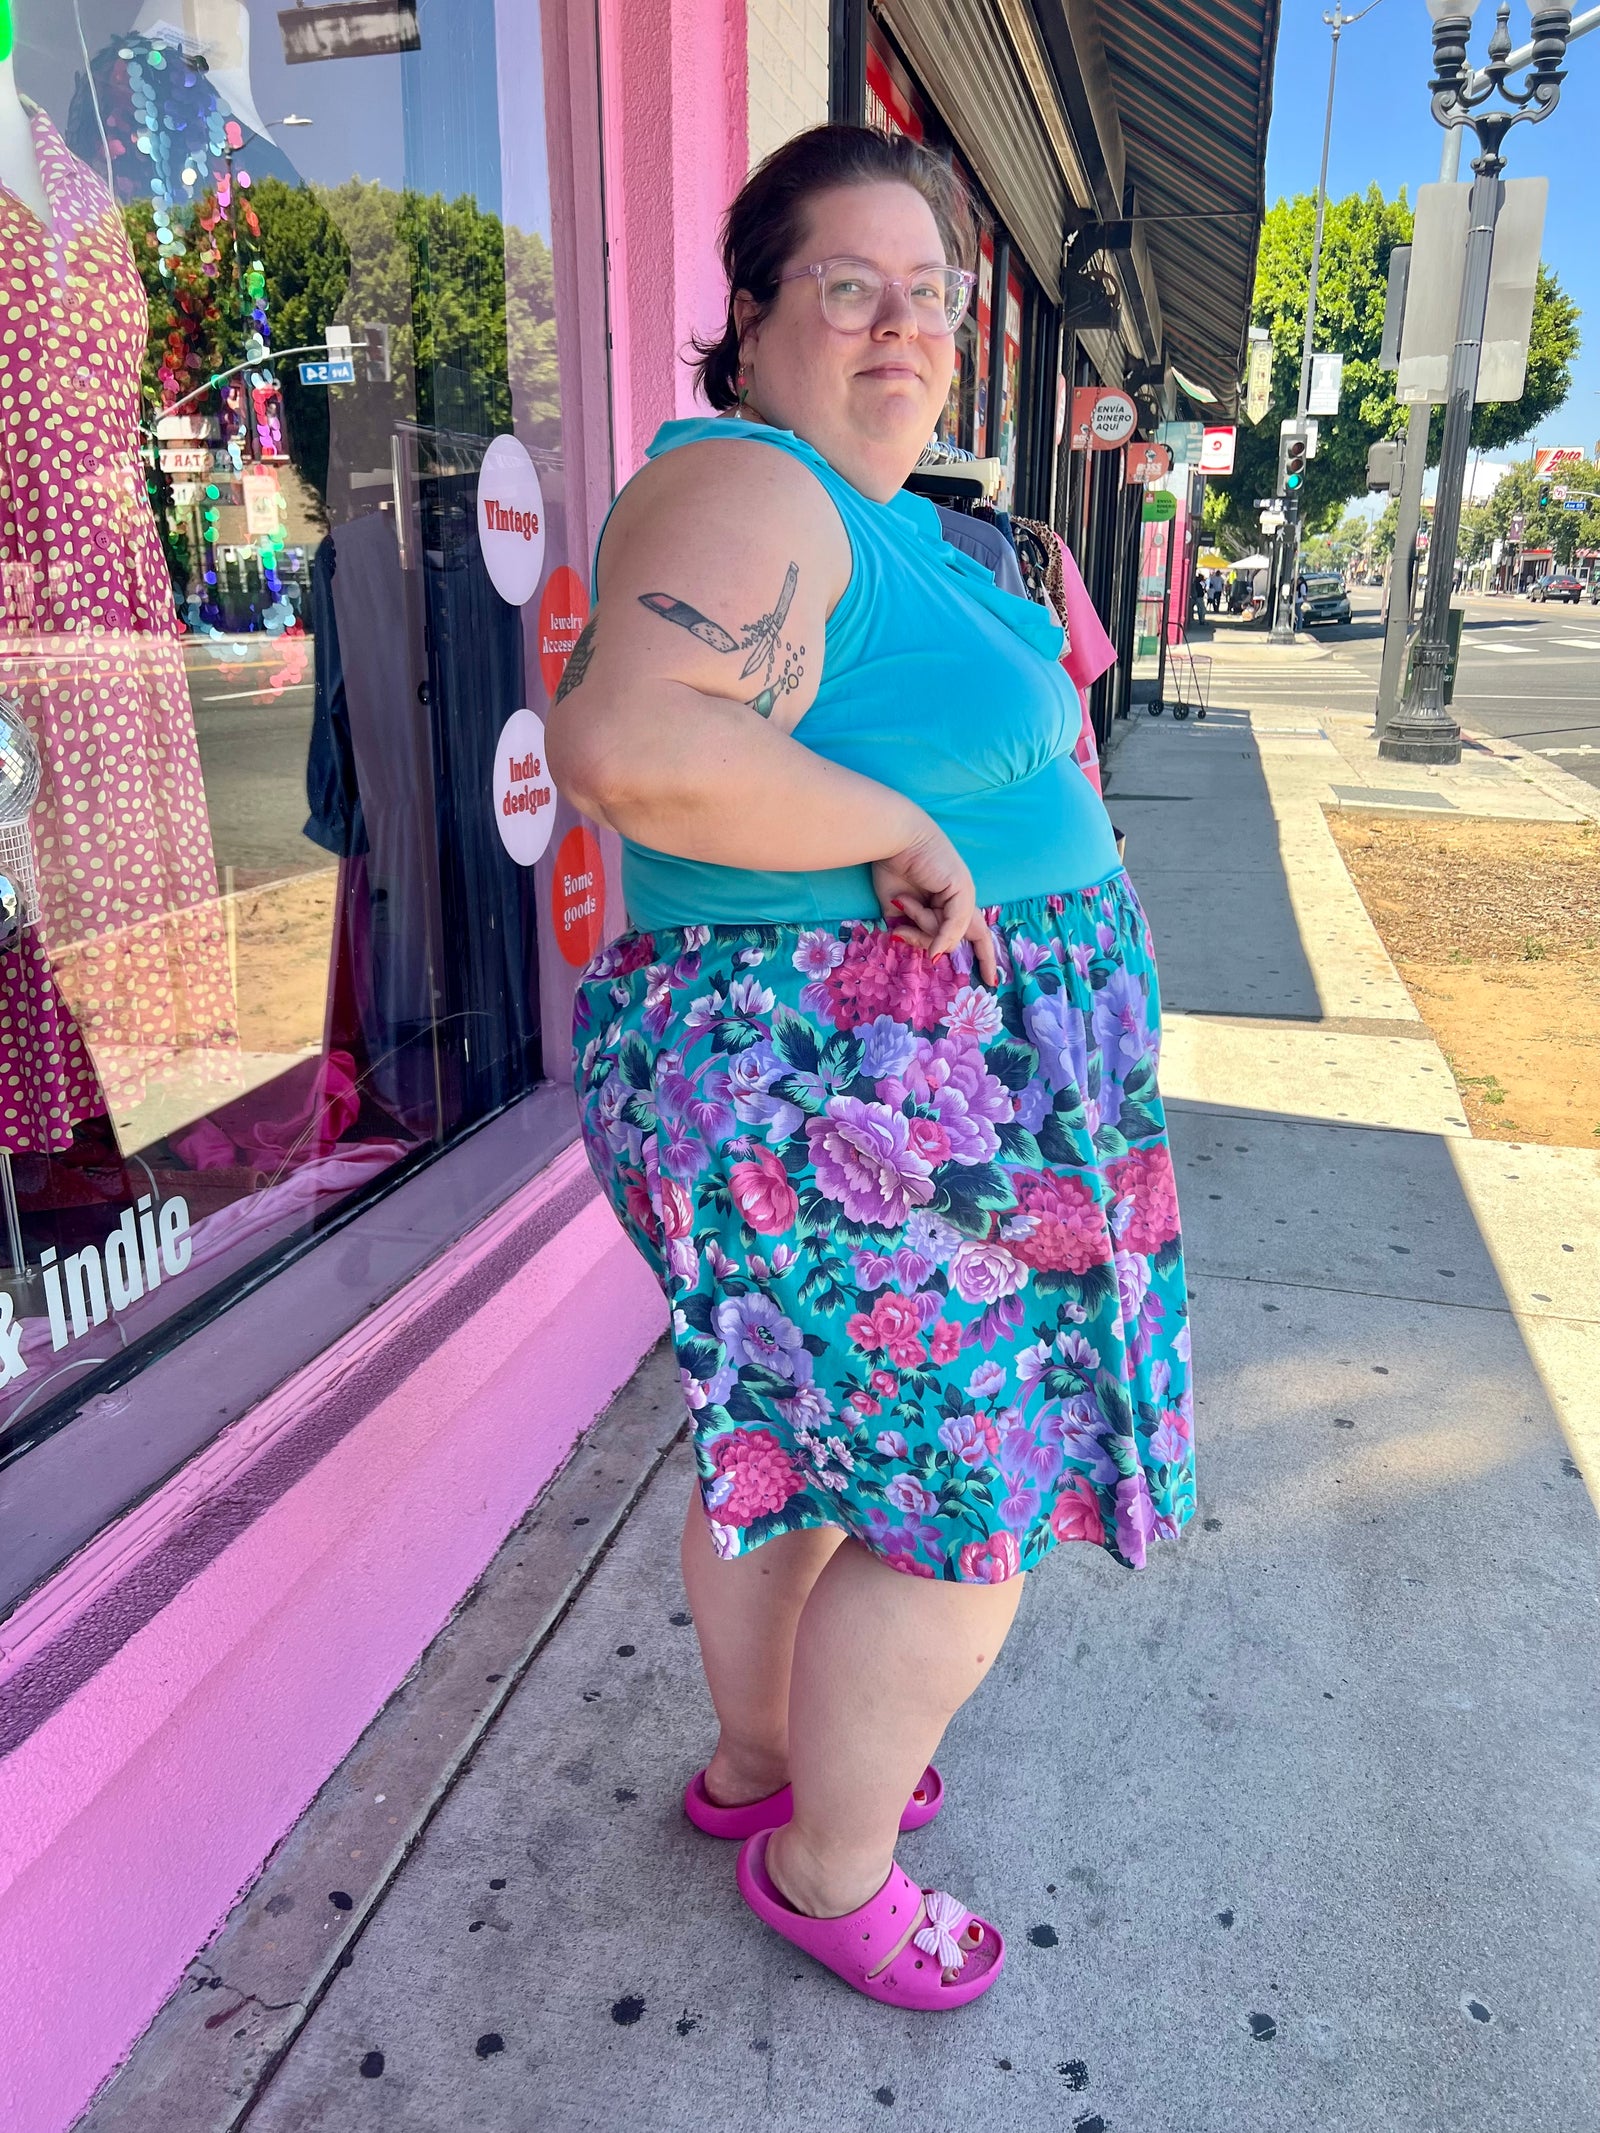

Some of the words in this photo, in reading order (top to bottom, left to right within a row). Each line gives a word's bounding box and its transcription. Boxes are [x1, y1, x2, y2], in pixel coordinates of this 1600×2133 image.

[1096, 414, 1132, 422] DINERO
[1097, 404, 1125, 413] ENVÍA
[1096, 422, 1120, 431] AQUÍ
[1552, 450, 1582, 461] Auto
[483, 499, 539, 541] Vintage
[509, 752, 541, 783] Indie
[502, 784, 551, 816] designs
[564, 871, 593, 897] Home
[564, 894, 597, 931] goods
[0, 1292, 29, 1389] &
[40, 1193, 192, 1353] indie
